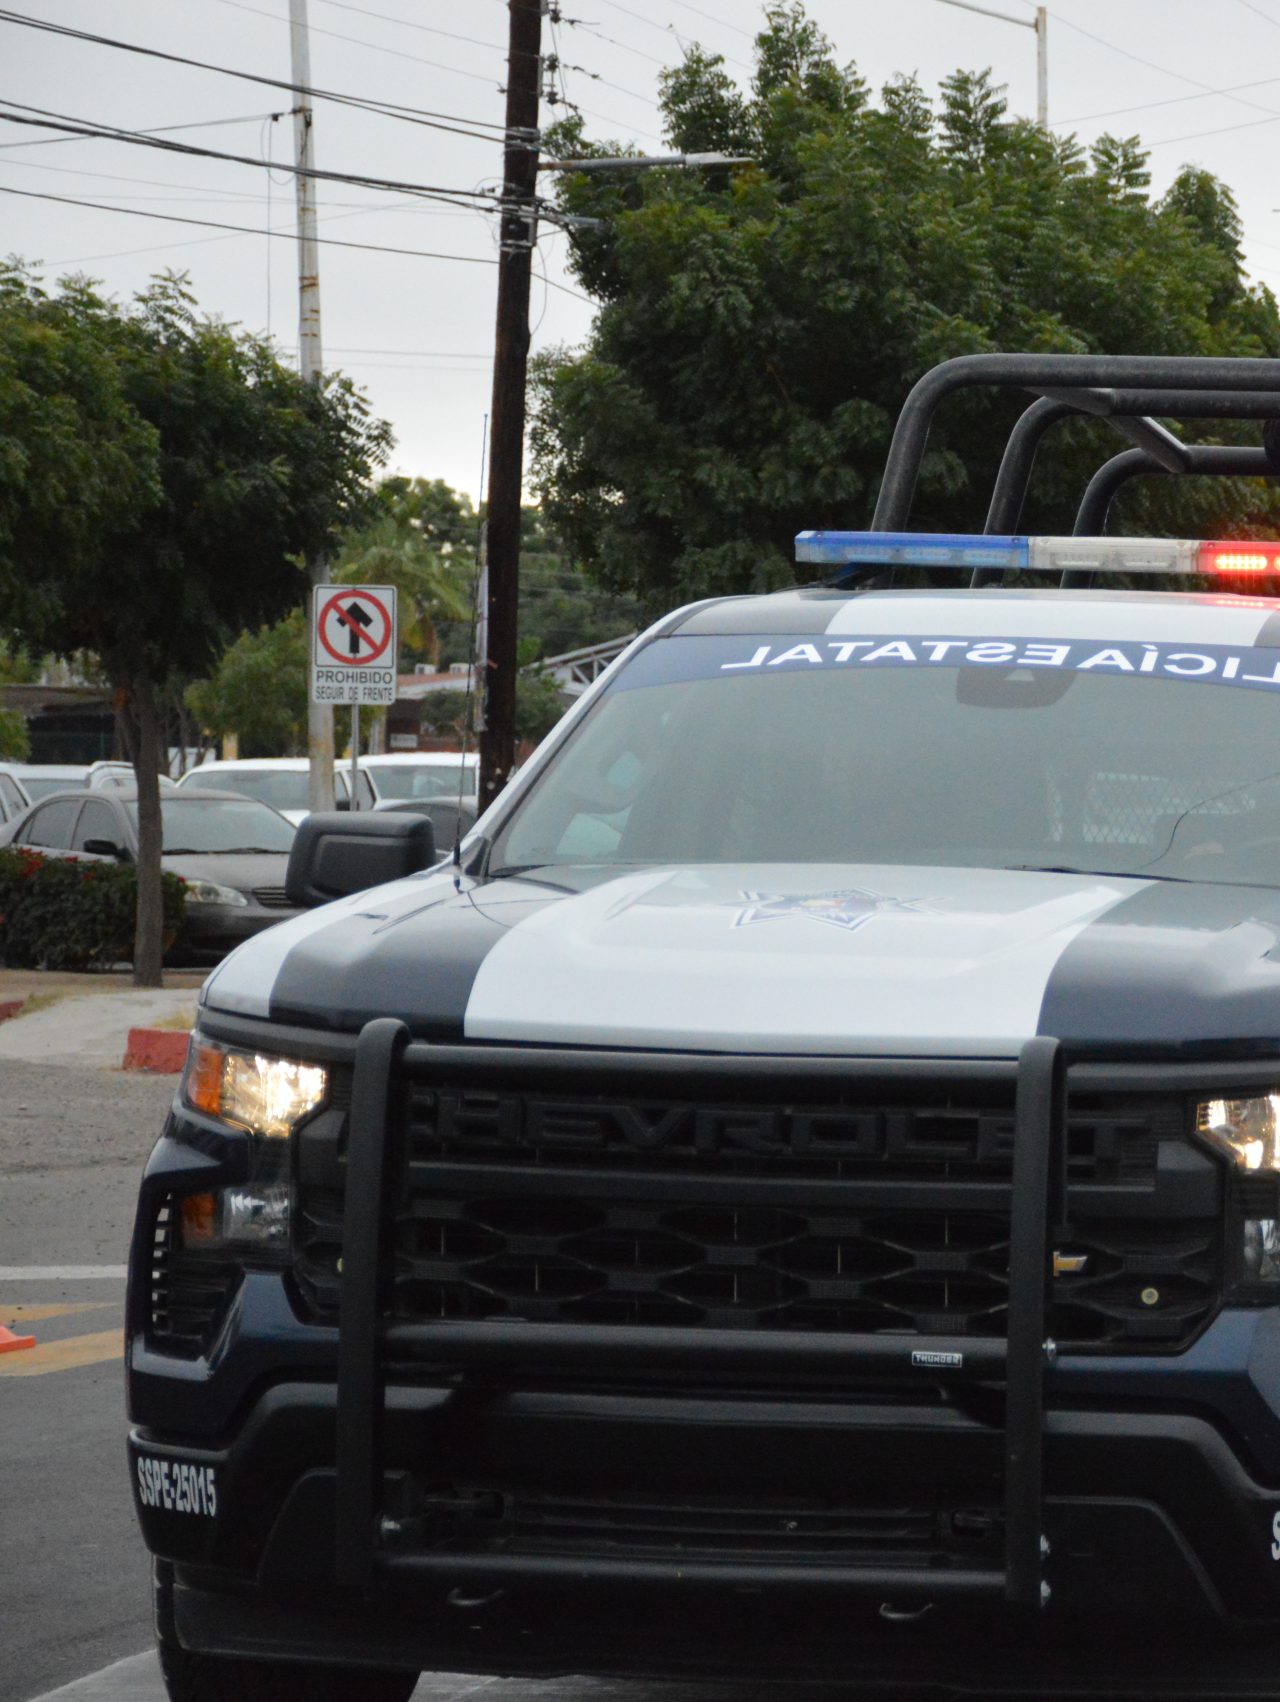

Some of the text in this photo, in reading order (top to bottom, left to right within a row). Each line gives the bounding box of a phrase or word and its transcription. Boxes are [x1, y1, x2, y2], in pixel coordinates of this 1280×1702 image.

[316, 670, 393, 684] PROHIBIDO
[316, 686, 393, 701] SEGUIR DE FRENTE
[915, 1353, 961, 1365] THUNDER
[138, 1456, 217, 1517] SSPE-25015
